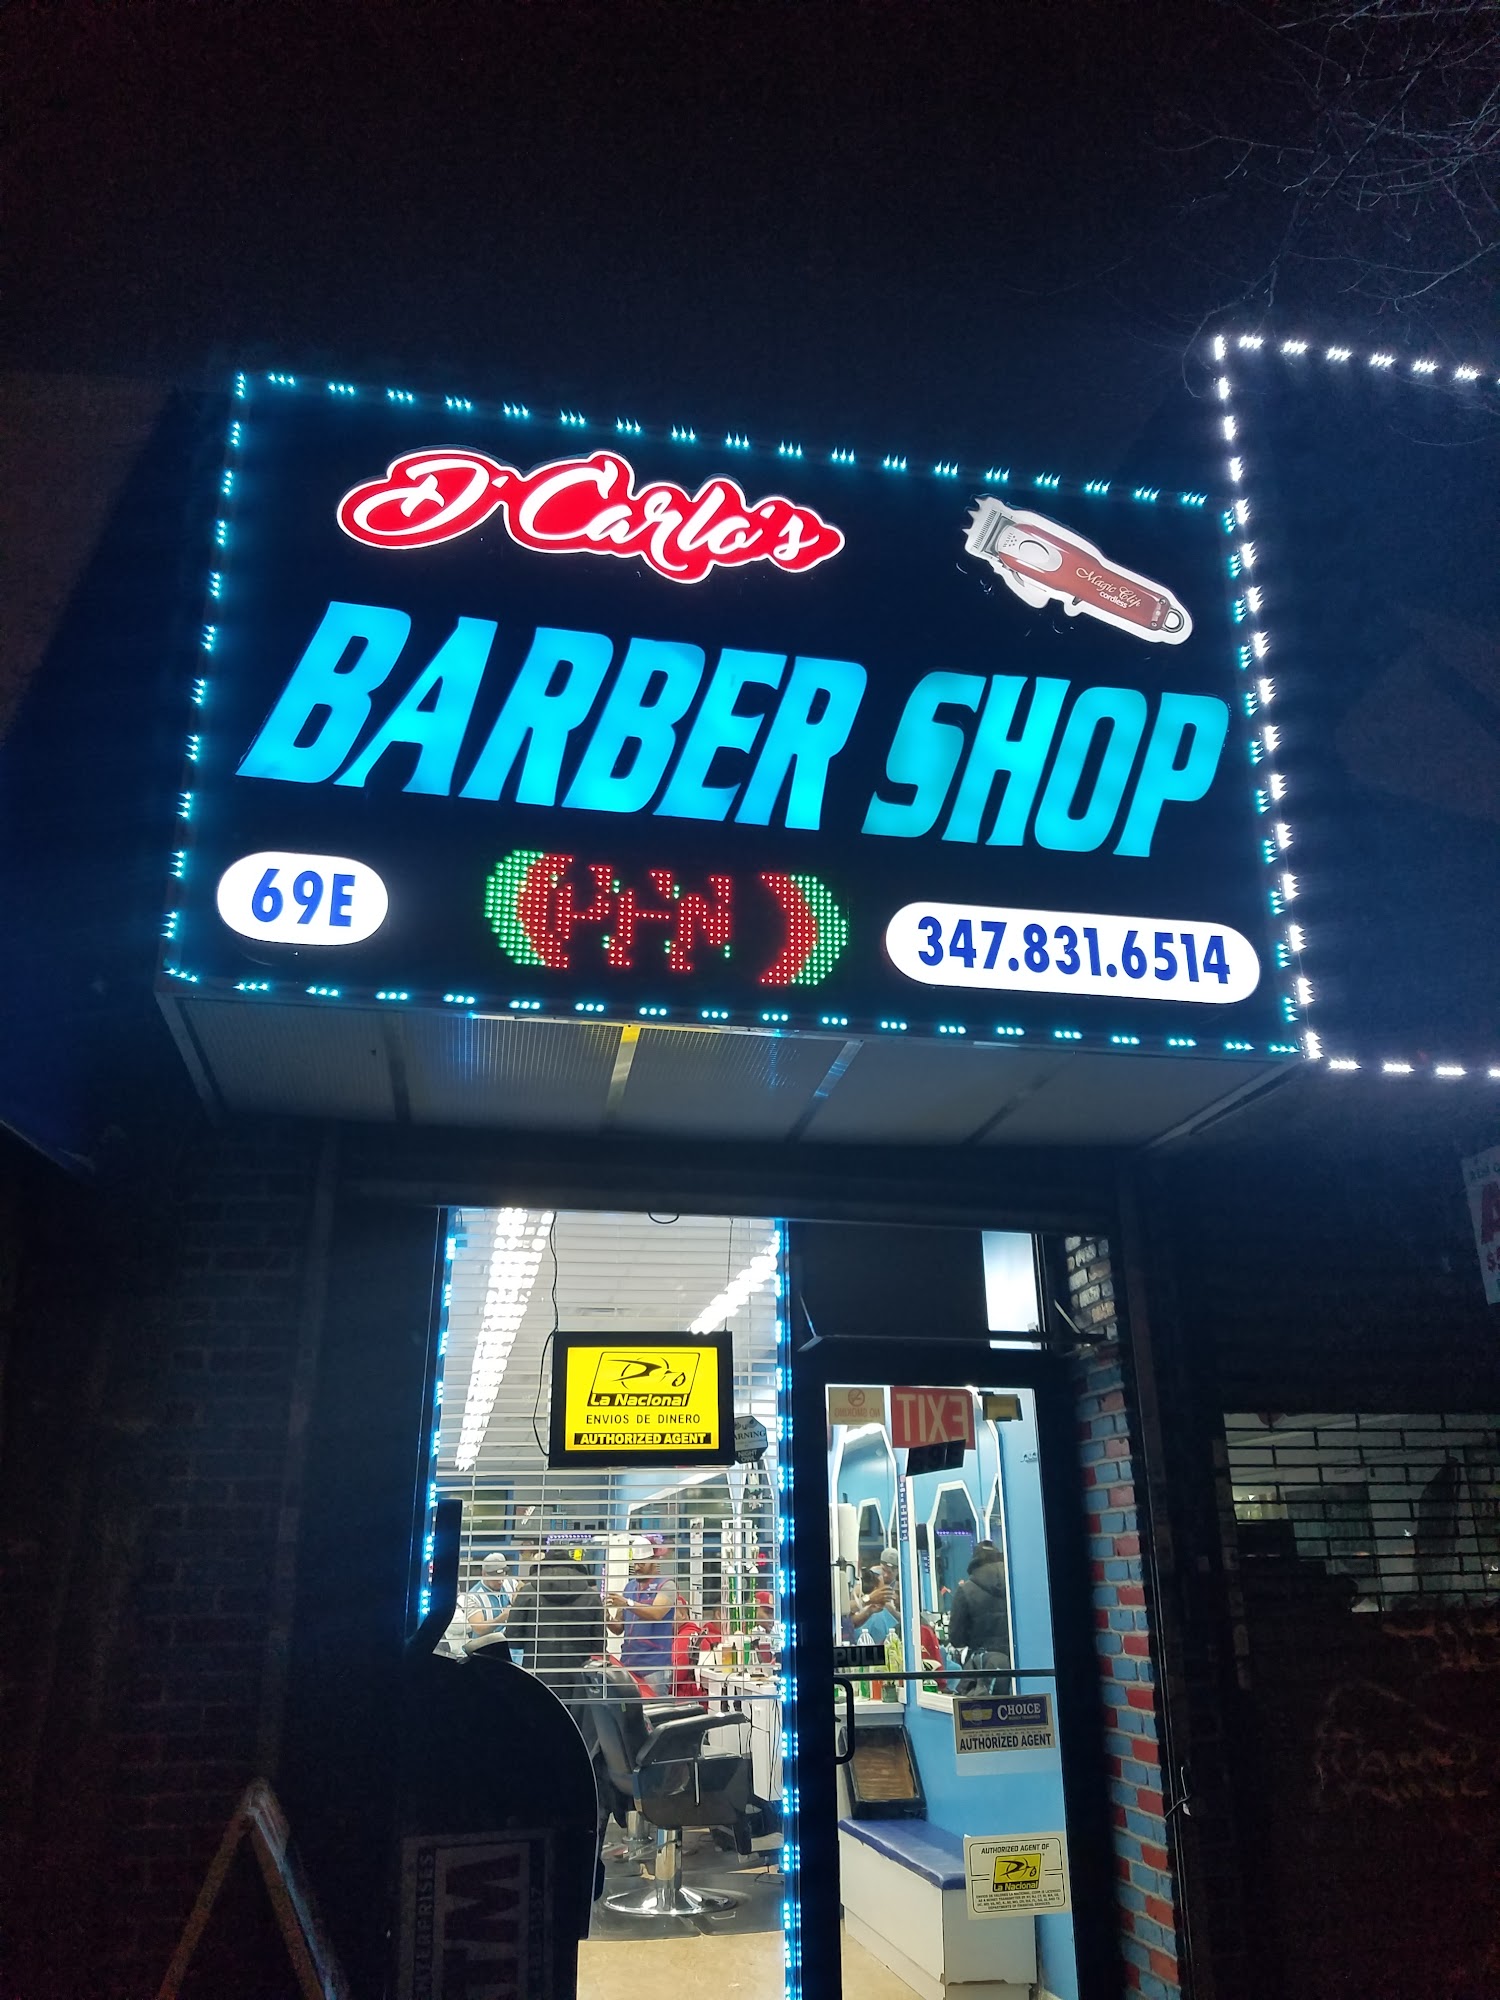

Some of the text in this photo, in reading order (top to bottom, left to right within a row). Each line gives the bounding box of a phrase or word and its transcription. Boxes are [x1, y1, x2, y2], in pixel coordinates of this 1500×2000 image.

[357, 457, 820, 572] D'Carlo's
[1076, 567, 1141, 608] Magic Clip
[1099, 591, 1128, 609] cordless
[236, 601, 1230, 858] BARBER SHOP
[250, 867, 356, 928] 69E
[917, 915, 1231, 985] 347.831.6514
[590, 1393, 688, 1407] La Nacional
[586, 1413, 701, 1425] ENVIOS DE DINERO
[580, 1432, 706, 1445] AUTHORIZED AGENT
[833, 1647, 885, 1666] PULL
[997, 1703, 1041, 1721] CHOICE
[960, 1733, 1052, 1751] AUTHORIZED AGENT
[980, 1844, 1019, 1854] AUTHORIZED
[1020, 1843, 1040, 1852] AGENT
[993, 1880, 1039, 1891] La Nacional
